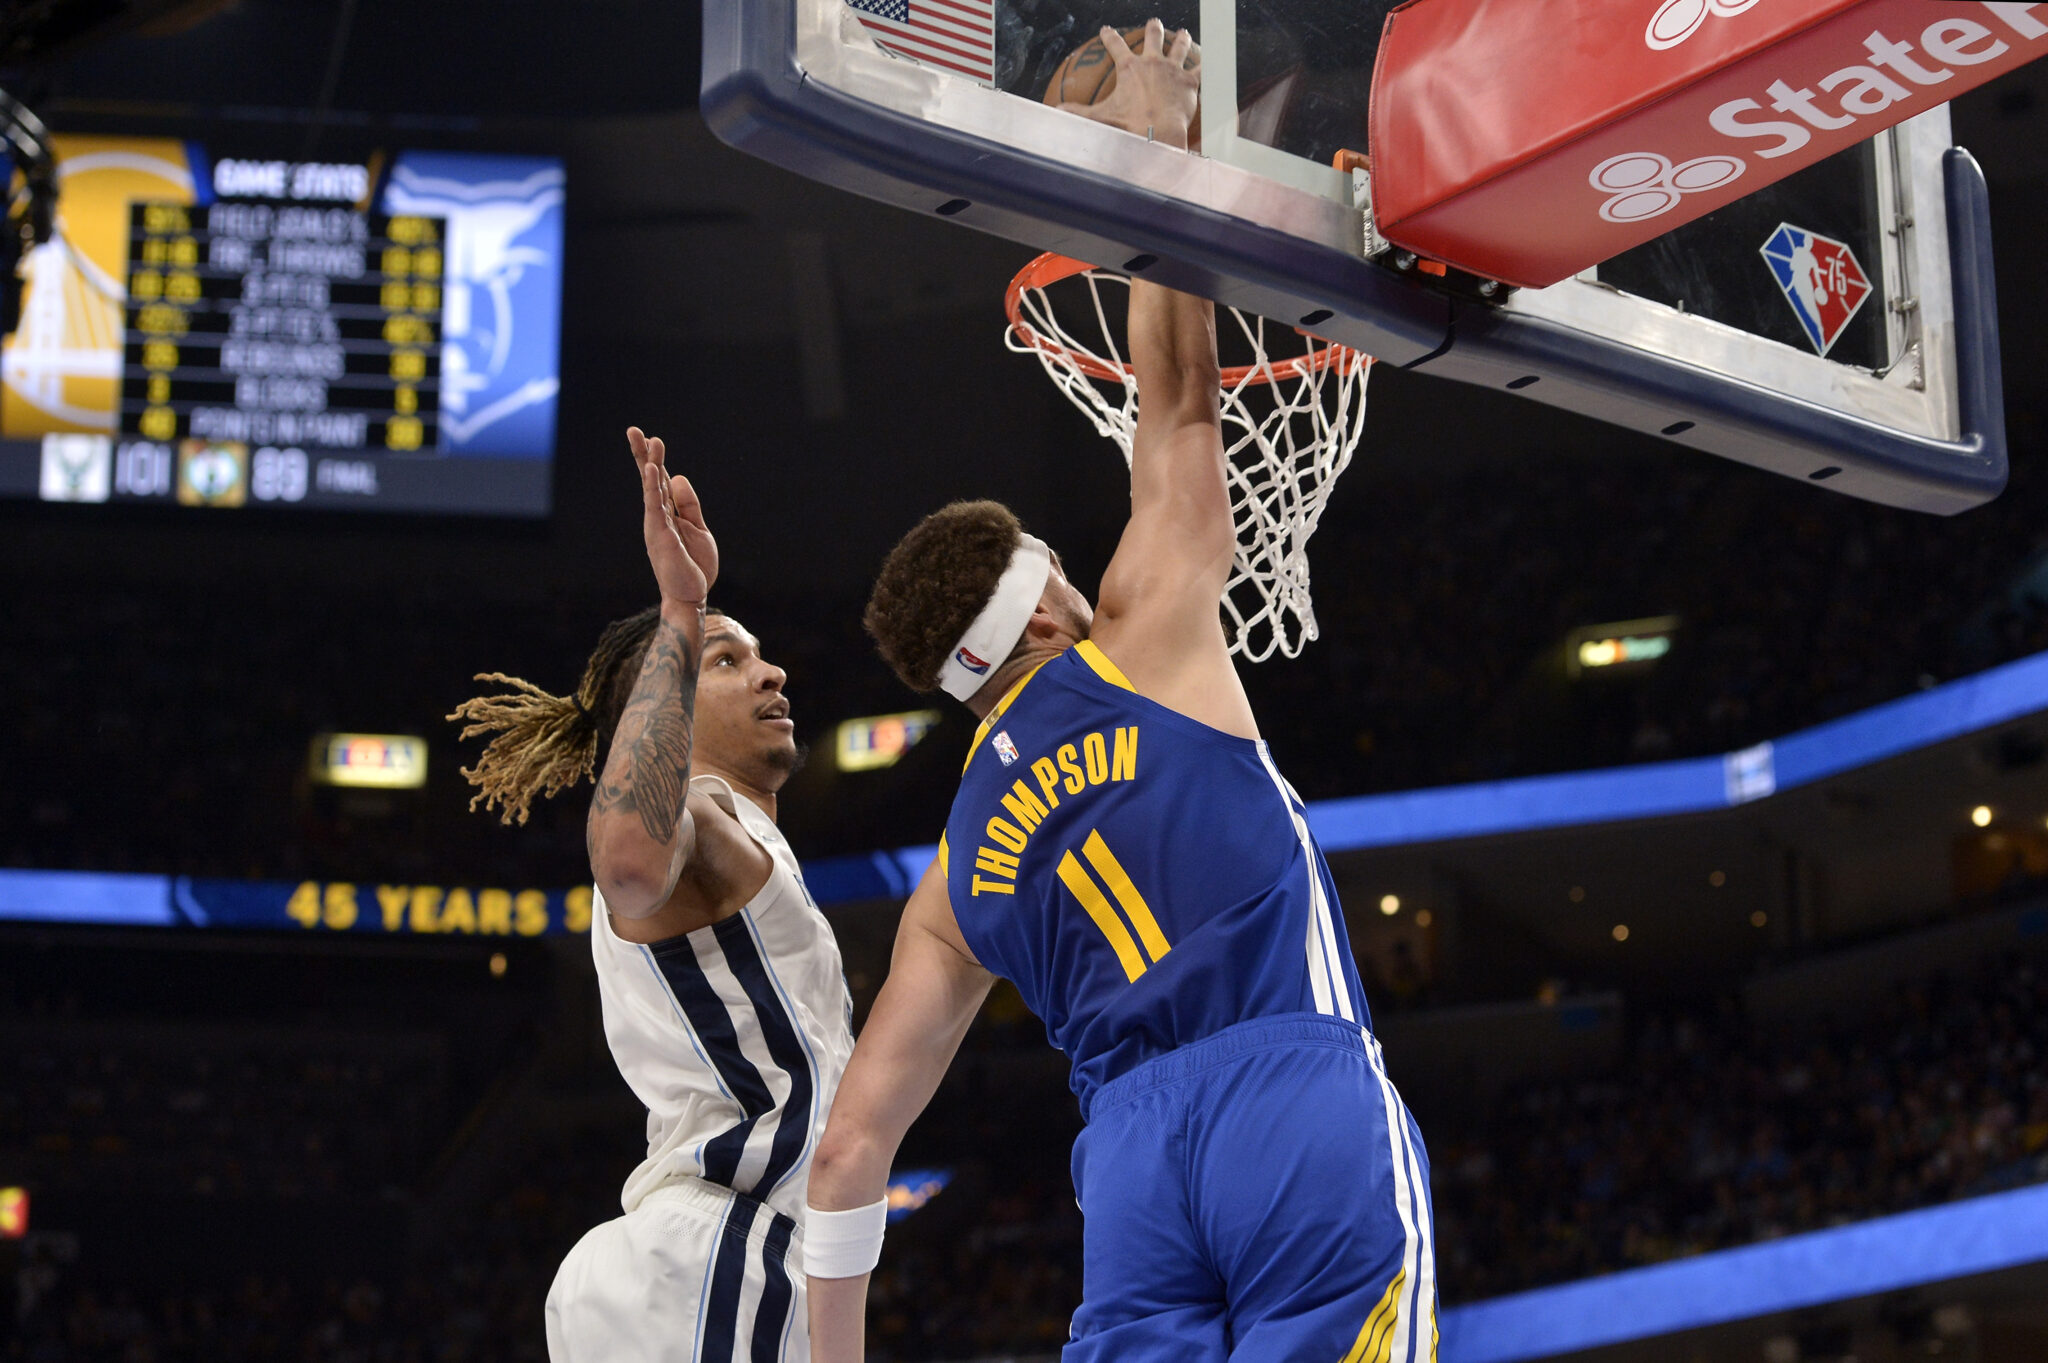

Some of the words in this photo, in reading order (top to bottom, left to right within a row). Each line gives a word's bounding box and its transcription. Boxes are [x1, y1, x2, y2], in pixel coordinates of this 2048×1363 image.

[1709, 18, 2010, 159] State
[1825, 255, 1848, 297] 75
[971, 725, 1139, 898] THOMPSON
[286, 881, 358, 930] 45
[376, 884, 549, 936] YEARS
[1056, 828, 1172, 984] 11
